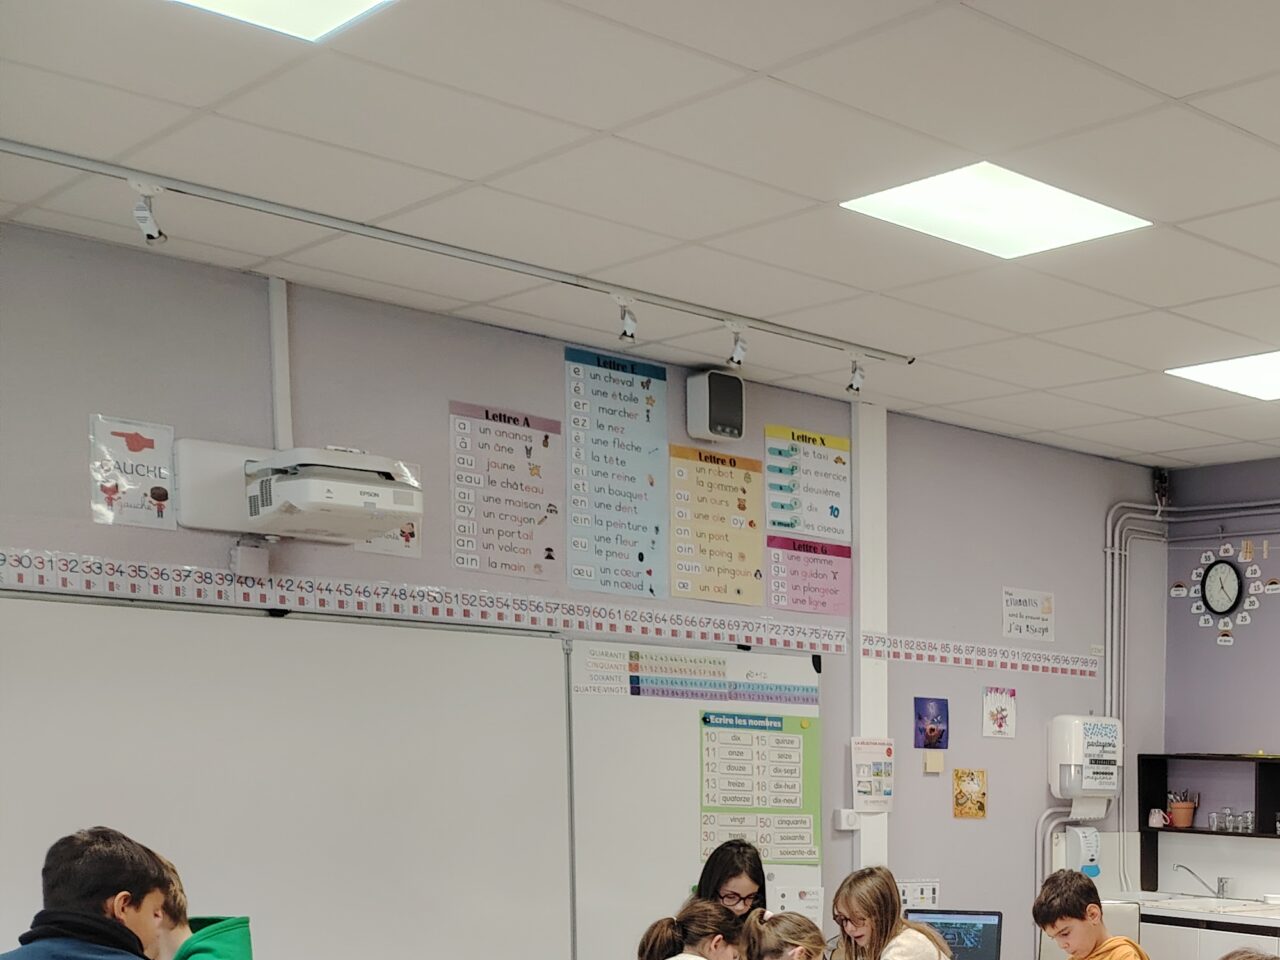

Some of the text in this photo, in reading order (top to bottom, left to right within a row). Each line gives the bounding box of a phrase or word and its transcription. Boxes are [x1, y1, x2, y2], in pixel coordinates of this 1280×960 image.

[573, 367, 581, 376] e
[604, 372, 635, 387] cheval
[573, 401, 588, 410] er
[485, 409, 531, 428] Lettre A
[458, 421, 466, 431] a
[479, 425, 533, 443] un ananas
[791, 431, 817, 445] Lettre
[478, 441, 491, 451] un
[457, 457, 473, 467] au
[698, 451, 727, 466] Lettre
[486, 459, 516, 472] jaune
[456, 474, 481, 485] eau
[487, 475, 544, 495] le château
[360, 490, 380, 498] EPSON
[482, 495, 541, 510] une maison
[458, 505, 474, 516] ay
[483, 510, 536, 527] un crayon
[606, 518, 648, 533] peinture
[482, 526, 534, 540] un portail
[456, 538, 474, 549] an
[482, 542, 532, 555] un volcan
[456, 553, 478, 566] ain
[500, 562, 526, 573] main
[717, 566, 752, 580] pingouin
[9, 554, 32, 569] 30
[33, 556, 54, 571] 31
[58, 558, 79, 574] 32
[81, 559, 103, 575] 33
[105, 562, 126, 577] 34
[127, 564, 149, 579] 35
[150, 566, 170, 581] 36
[172, 568, 192, 583] 37
[194, 570, 213, 585] 38
[215, 572, 234, 586] 39
[236, 576, 256, 588] 40
[257, 577, 275, 590] 41
[276, 578, 295, 592] 42
[297, 580, 314, 593] 43
[316, 582, 333, 595] 44
[335, 583, 353, 597] 45
[355, 585, 371, 598] 46
[373, 586, 390, 598] 47
[390, 587, 407, 600] 48
[408, 589, 425, 602] 49
[444, 592, 459, 605] 51
[461, 593, 477, 607] 52
[479, 595, 495, 608] 53
[512, 599, 528, 611] 55
[528, 600, 544, 613] 56
[561, 603, 576, 616] 58
[593, 607, 607, 619] 60
[624, 610, 638, 622] 62
[654, 612, 668, 624] 64
[684, 615, 698, 627] 66
[713, 618, 726, 630] 68
[741, 620, 755, 632] 70
[768, 623, 782, 635] 72
[862, 635, 874, 646] 78
[748, 717, 782, 728] nombres
[705, 731, 717, 743] 10
[756, 736, 767, 747] 15
[703, 815, 716, 825] 20
[759, 818, 772, 828] 50
[703, 831, 716, 842] 30
[759, 833, 772, 844] 60
